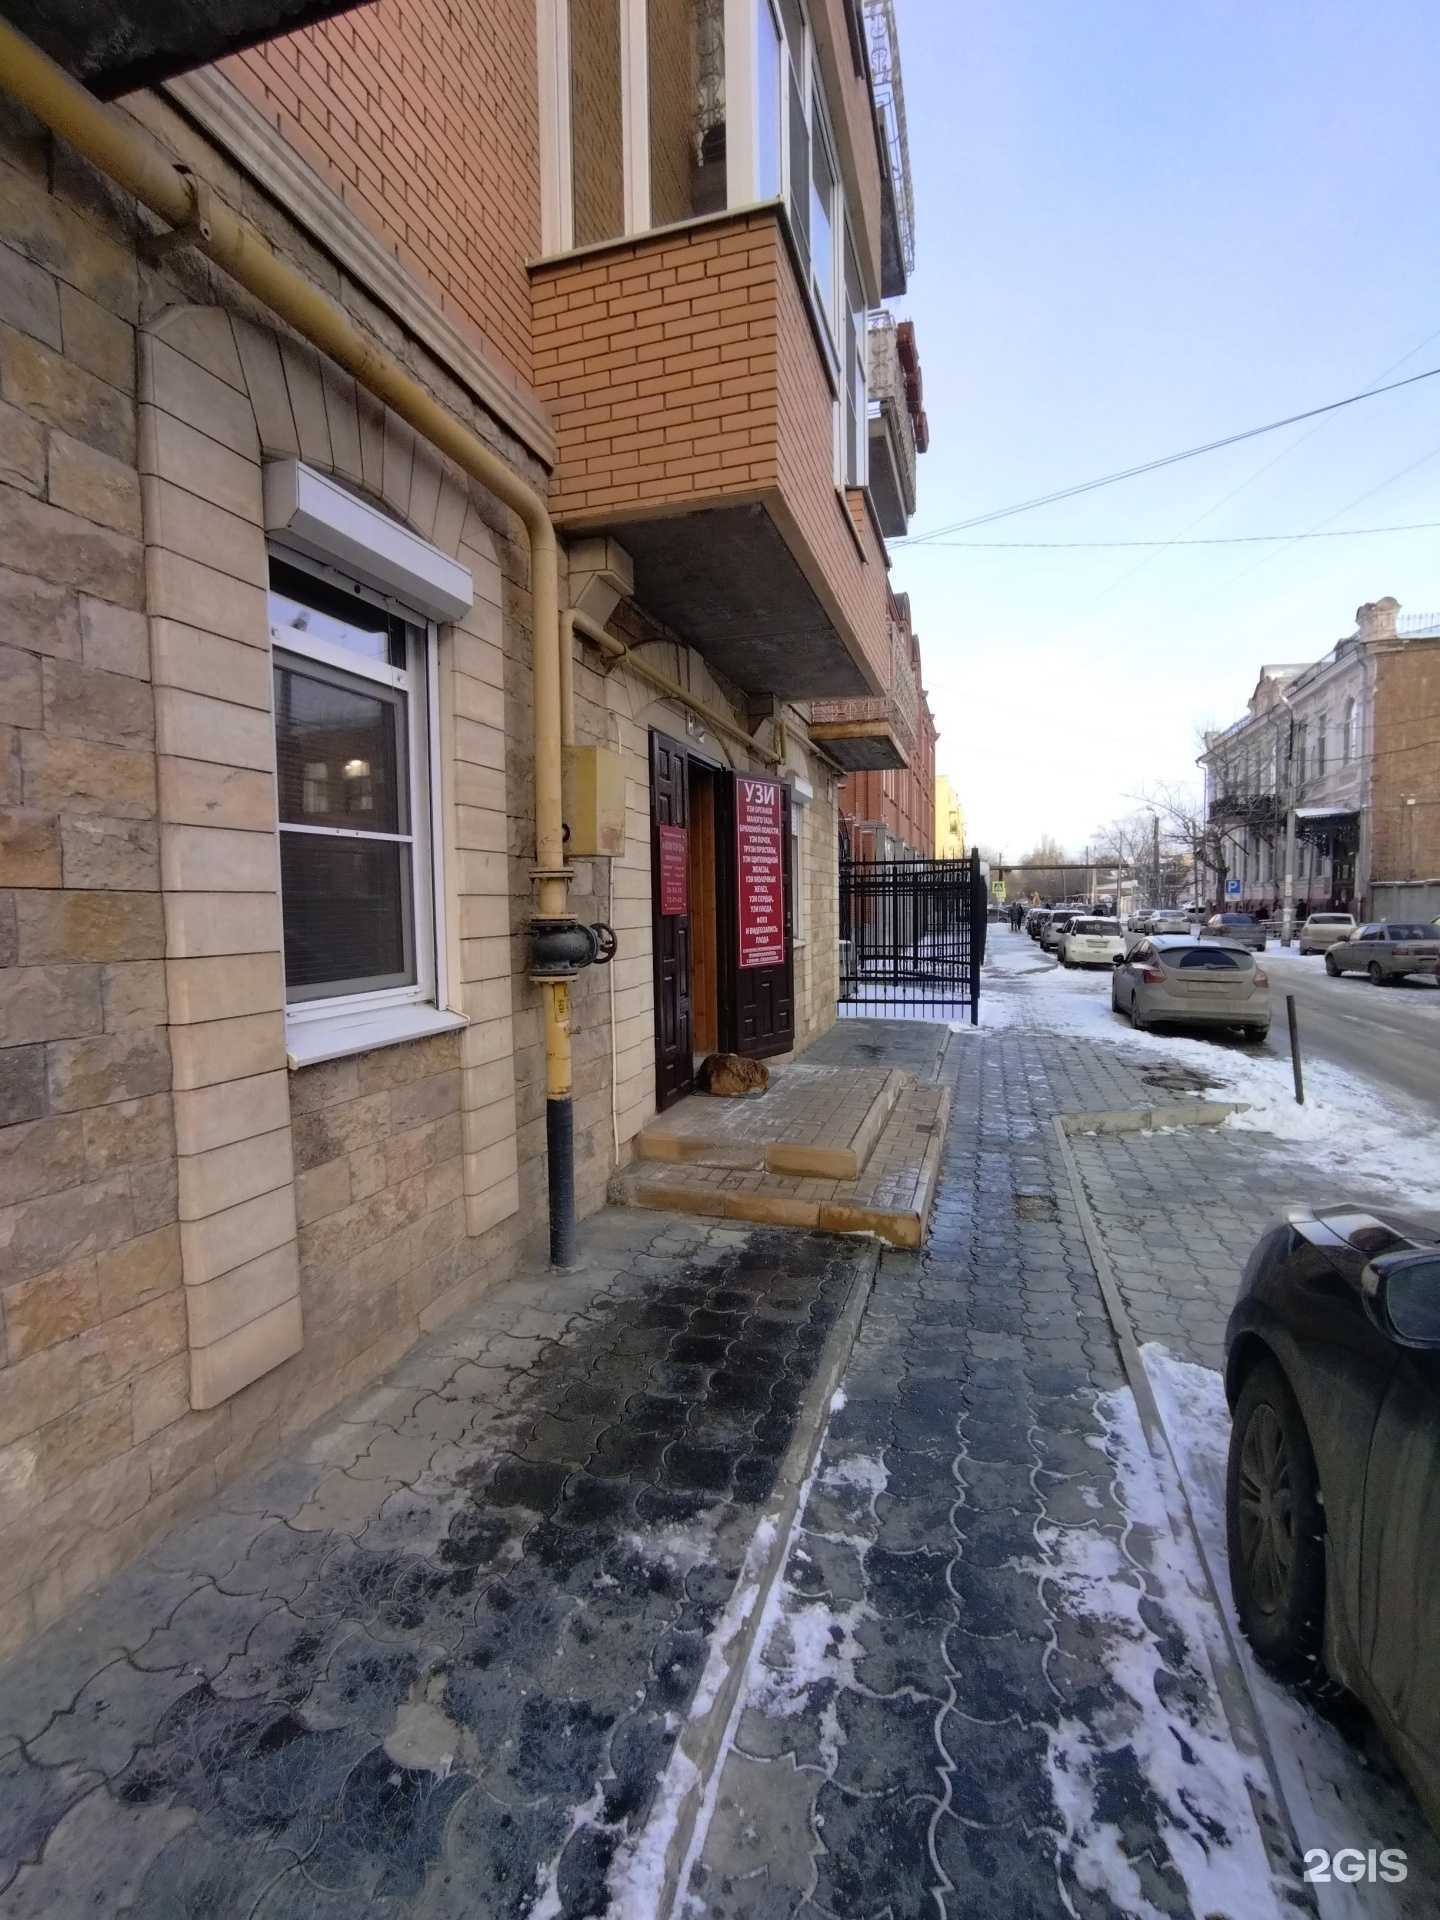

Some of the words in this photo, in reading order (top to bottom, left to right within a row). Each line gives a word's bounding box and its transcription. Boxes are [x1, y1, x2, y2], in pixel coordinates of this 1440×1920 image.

[744, 783, 775, 805] УЗИ
[749, 836, 757, 844] УЗИ
[1229, 881, 1238, 892] P
